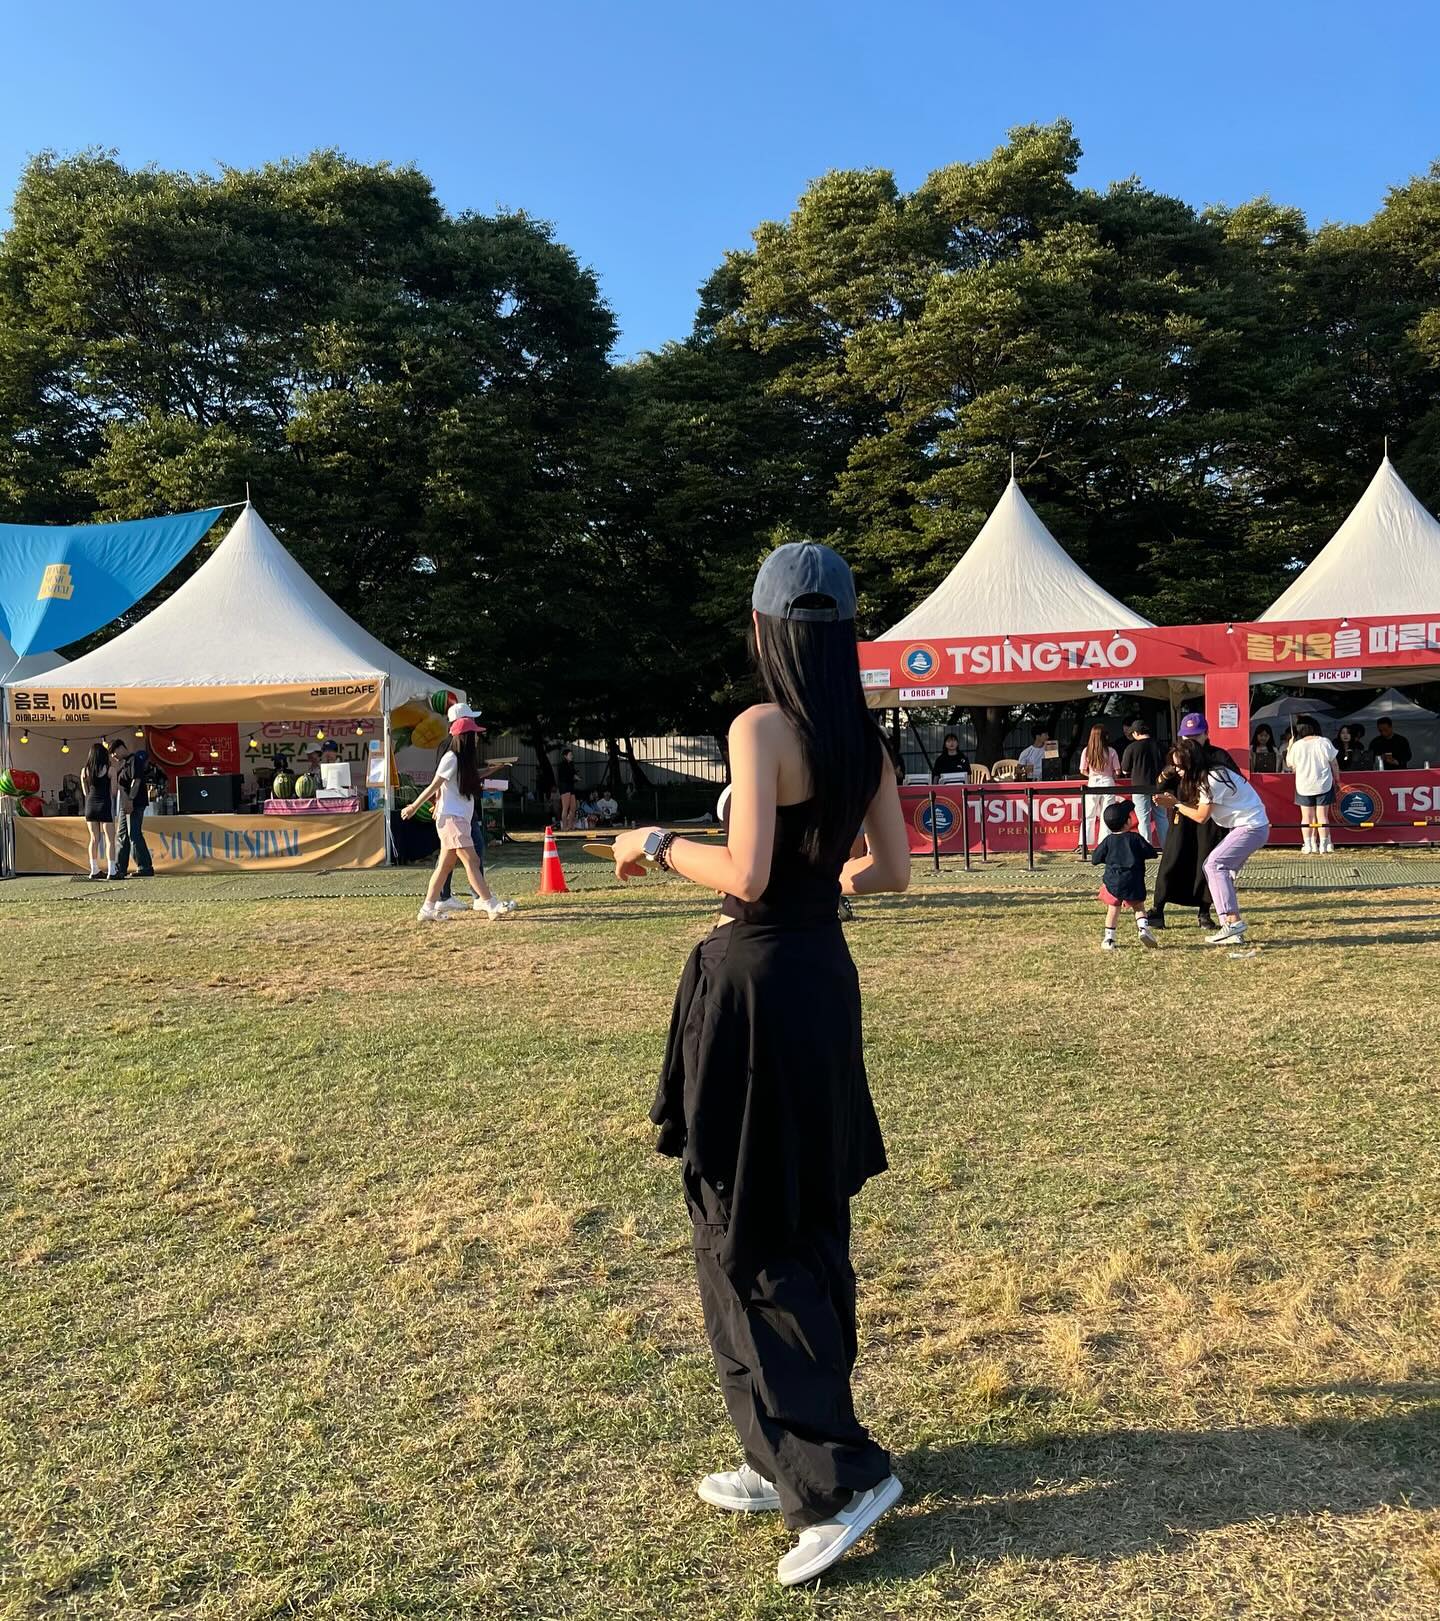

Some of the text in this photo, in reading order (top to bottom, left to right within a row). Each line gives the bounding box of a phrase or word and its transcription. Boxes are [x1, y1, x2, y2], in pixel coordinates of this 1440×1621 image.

[1247, 629, 1361, 662] 즐거움을
[945, 638, 1138, 675] TSINGTAO
[1319, 671, 1351, 680] PICK-UP
[1102, 680, 1134, 689] PICK-UP
[911, 689, 936, 697] ORDER
[14, 692, 117, 711] 음료, 에이드
[15, 713, 57, 722] 아메리카노
[65, 713, 90, 722] 에이드
[223, 829, 302, 859] FESTIVAL
